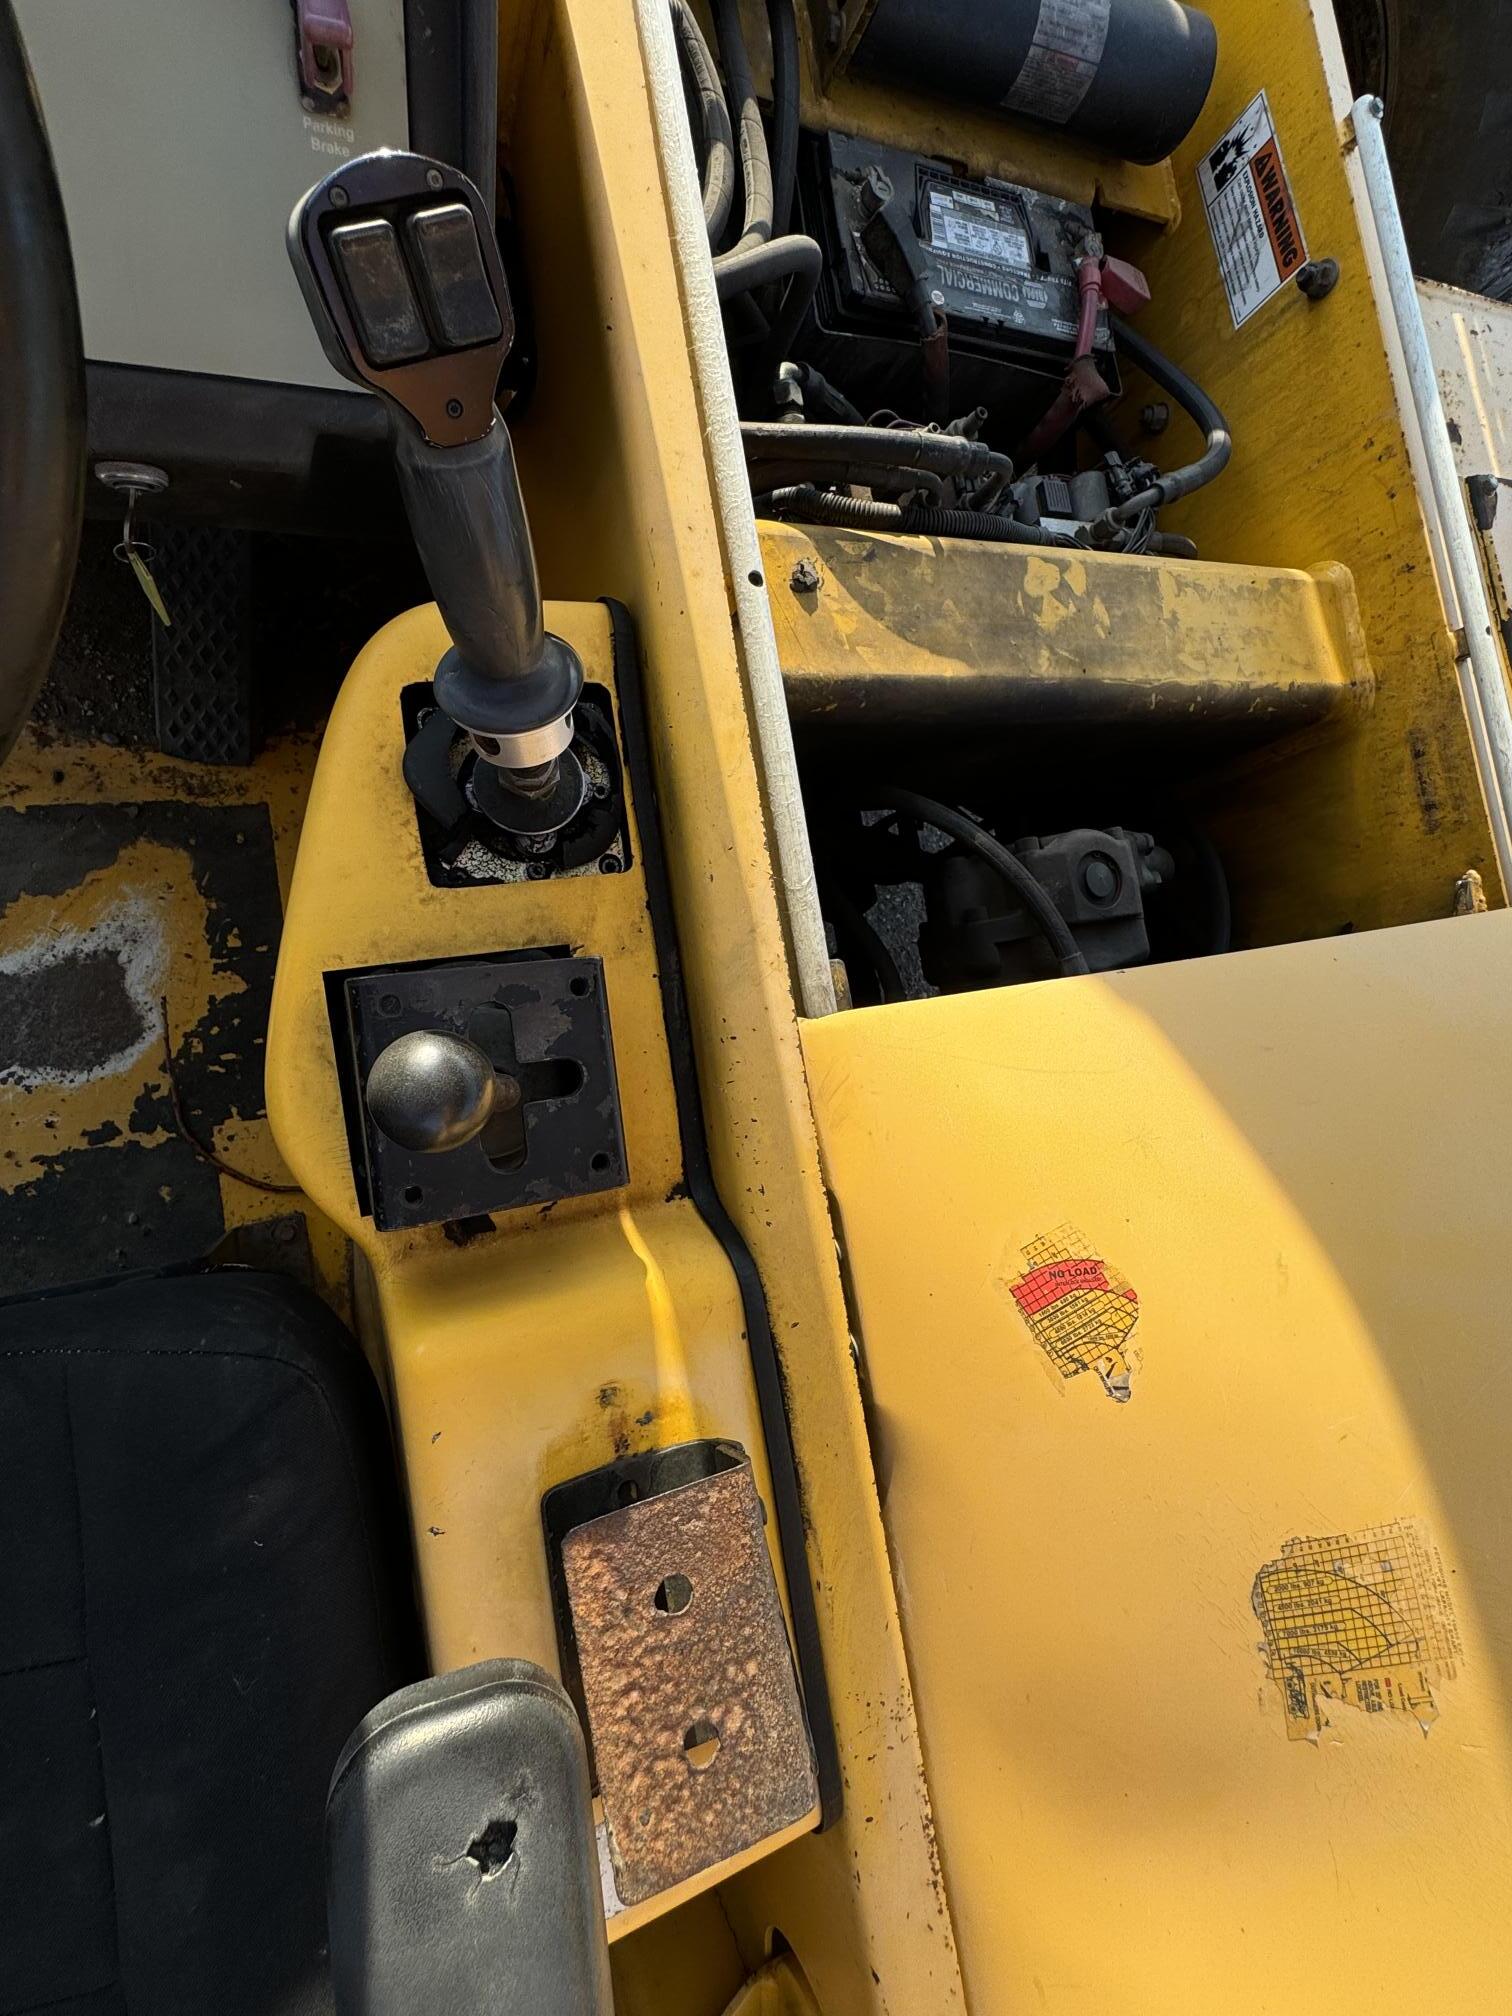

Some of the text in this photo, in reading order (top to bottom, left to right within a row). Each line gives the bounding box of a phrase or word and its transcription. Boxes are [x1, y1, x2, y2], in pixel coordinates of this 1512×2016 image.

[303, 116, 354, 143] Parking
[311, 137, 350, 157] Brake
[1242, 170, 1257, 208] EXPLOSION
[1252, 206, 1265, 240] HAZARD
[1261, 165, 1298, 269] WARNING
[936, 264, 1020, 302] COMMERCIAL
[1049, 1267, 1098, 1280] NO LOAD
[1316, 1578, 1324, 1586] kg
[1323, 1598, 1333, 1606] kg
[1330, 1623, 1339, 1632] kg
